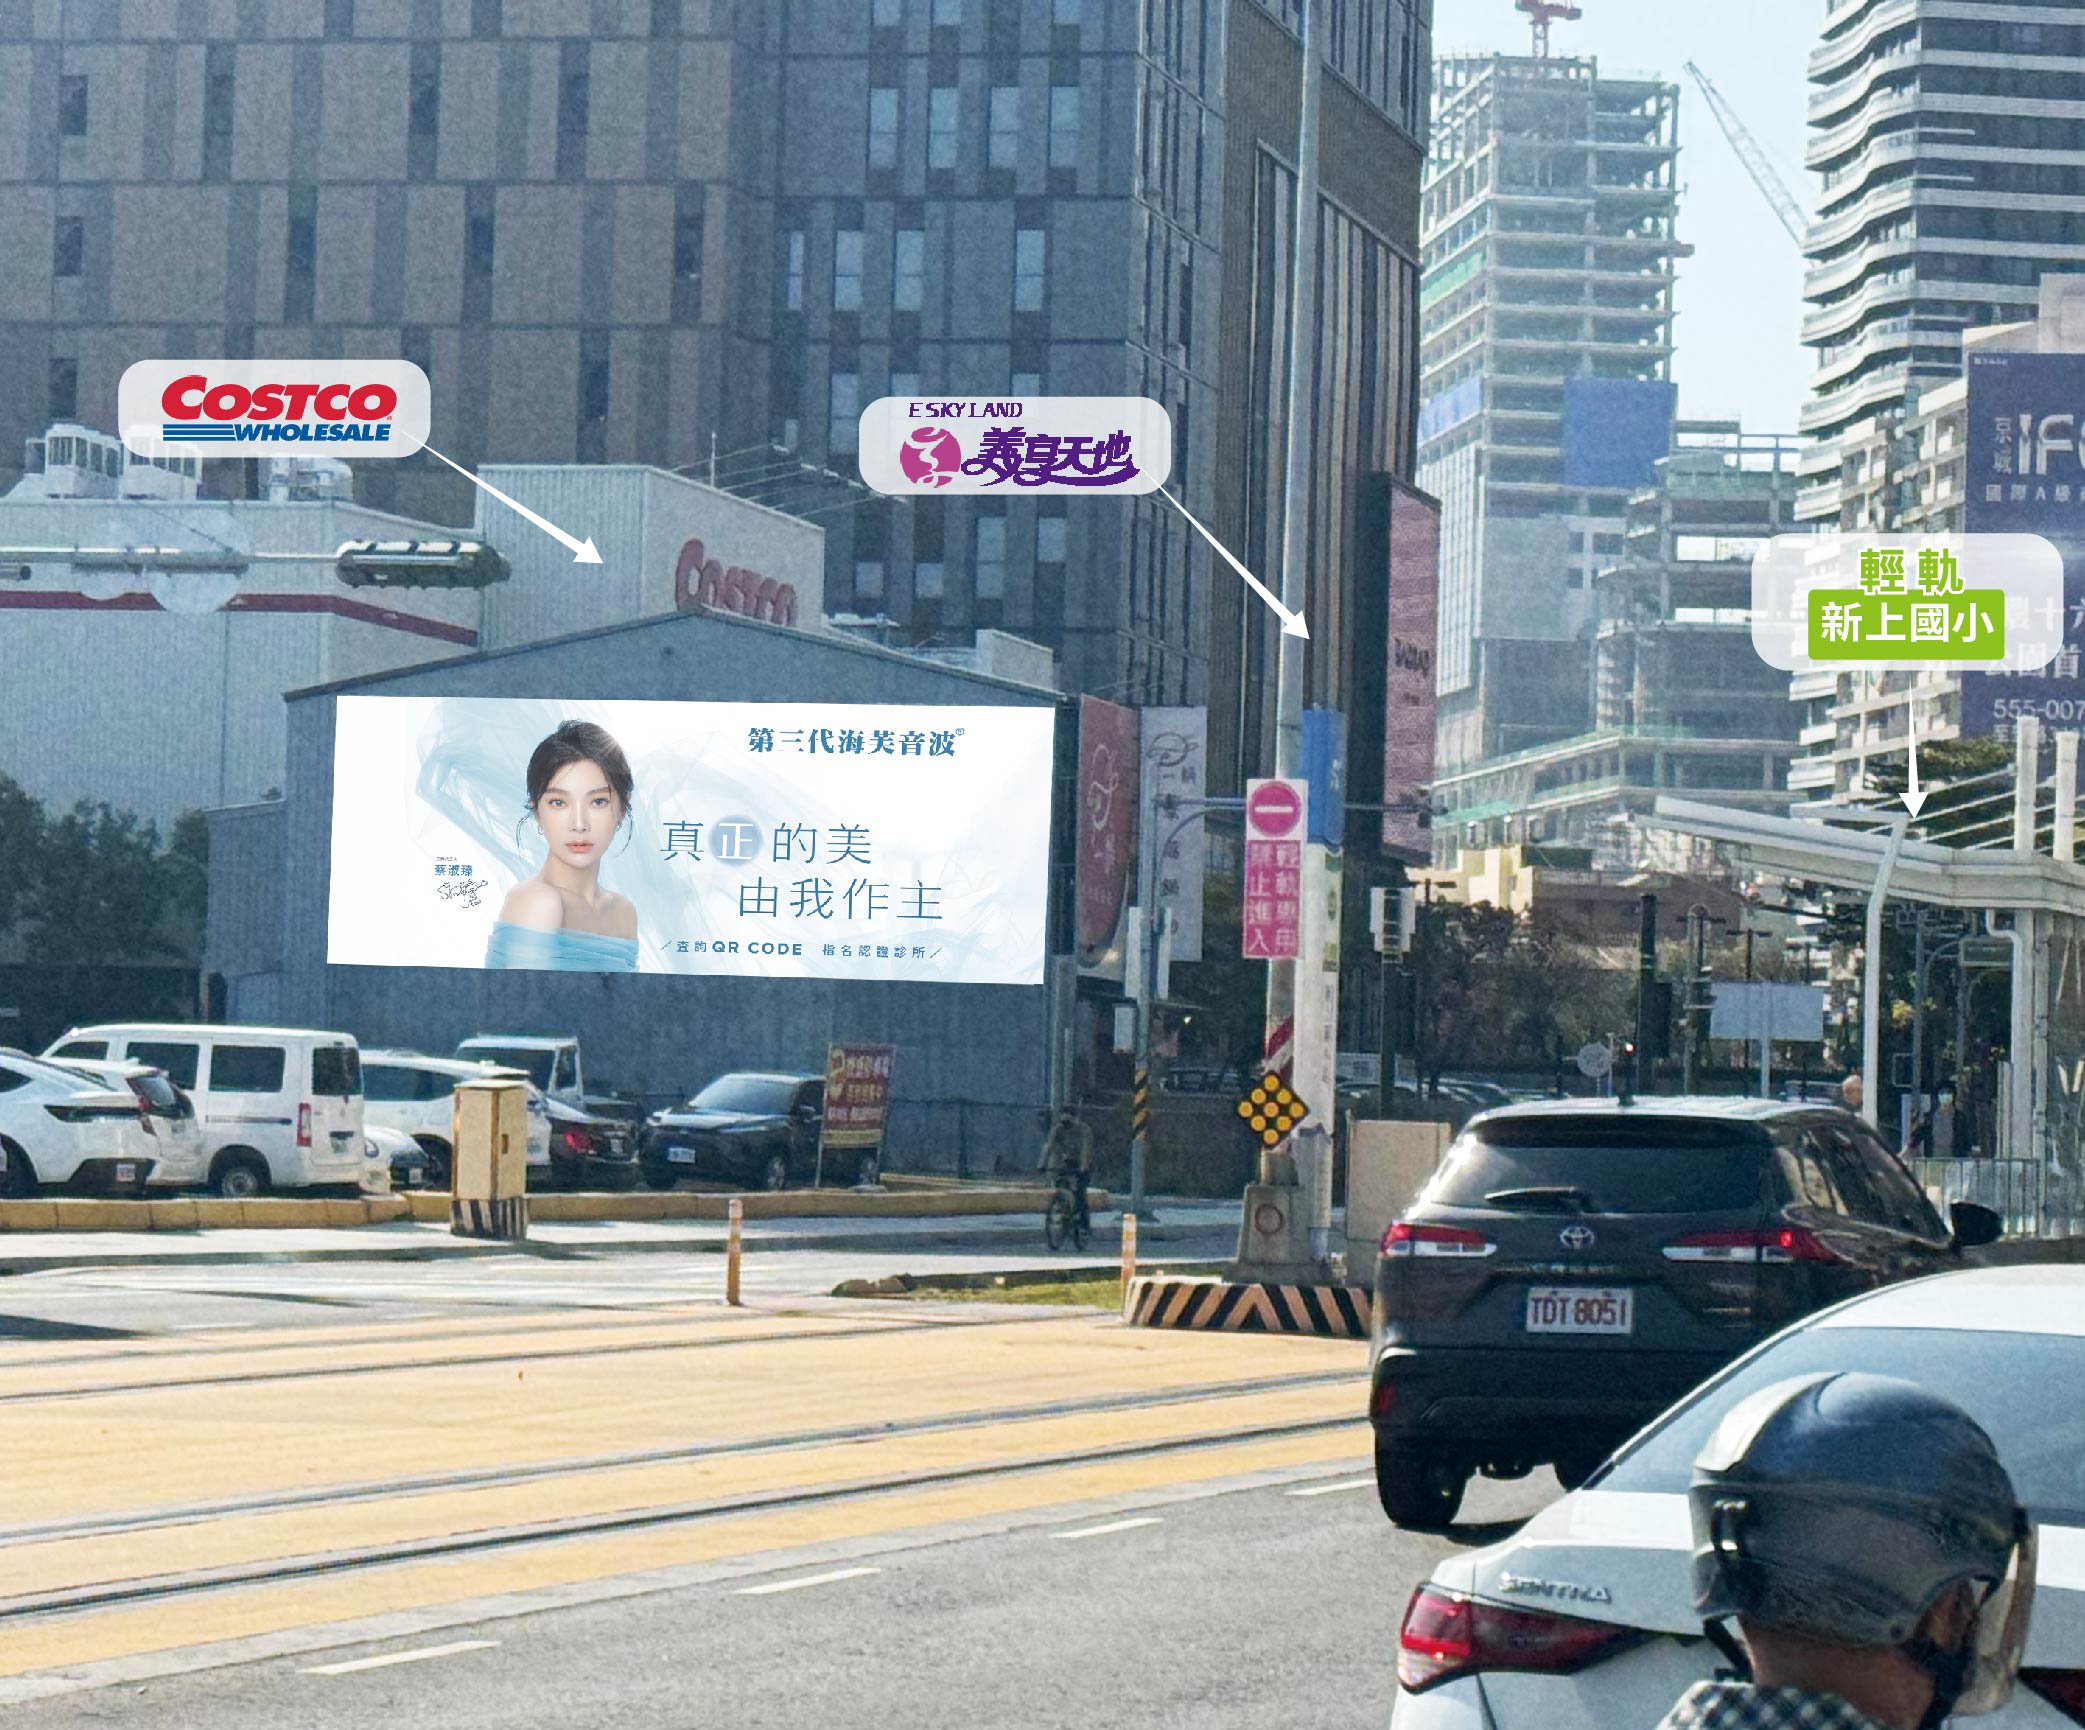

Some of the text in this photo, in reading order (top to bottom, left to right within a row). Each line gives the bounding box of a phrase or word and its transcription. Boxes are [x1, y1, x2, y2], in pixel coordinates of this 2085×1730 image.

[2018, 413, 2085, 475] IF
[660, 820, 871, 864] 真正的美
[740, 876, 942, 919] 由我作主
[748, 942, 803, 956] CODE
